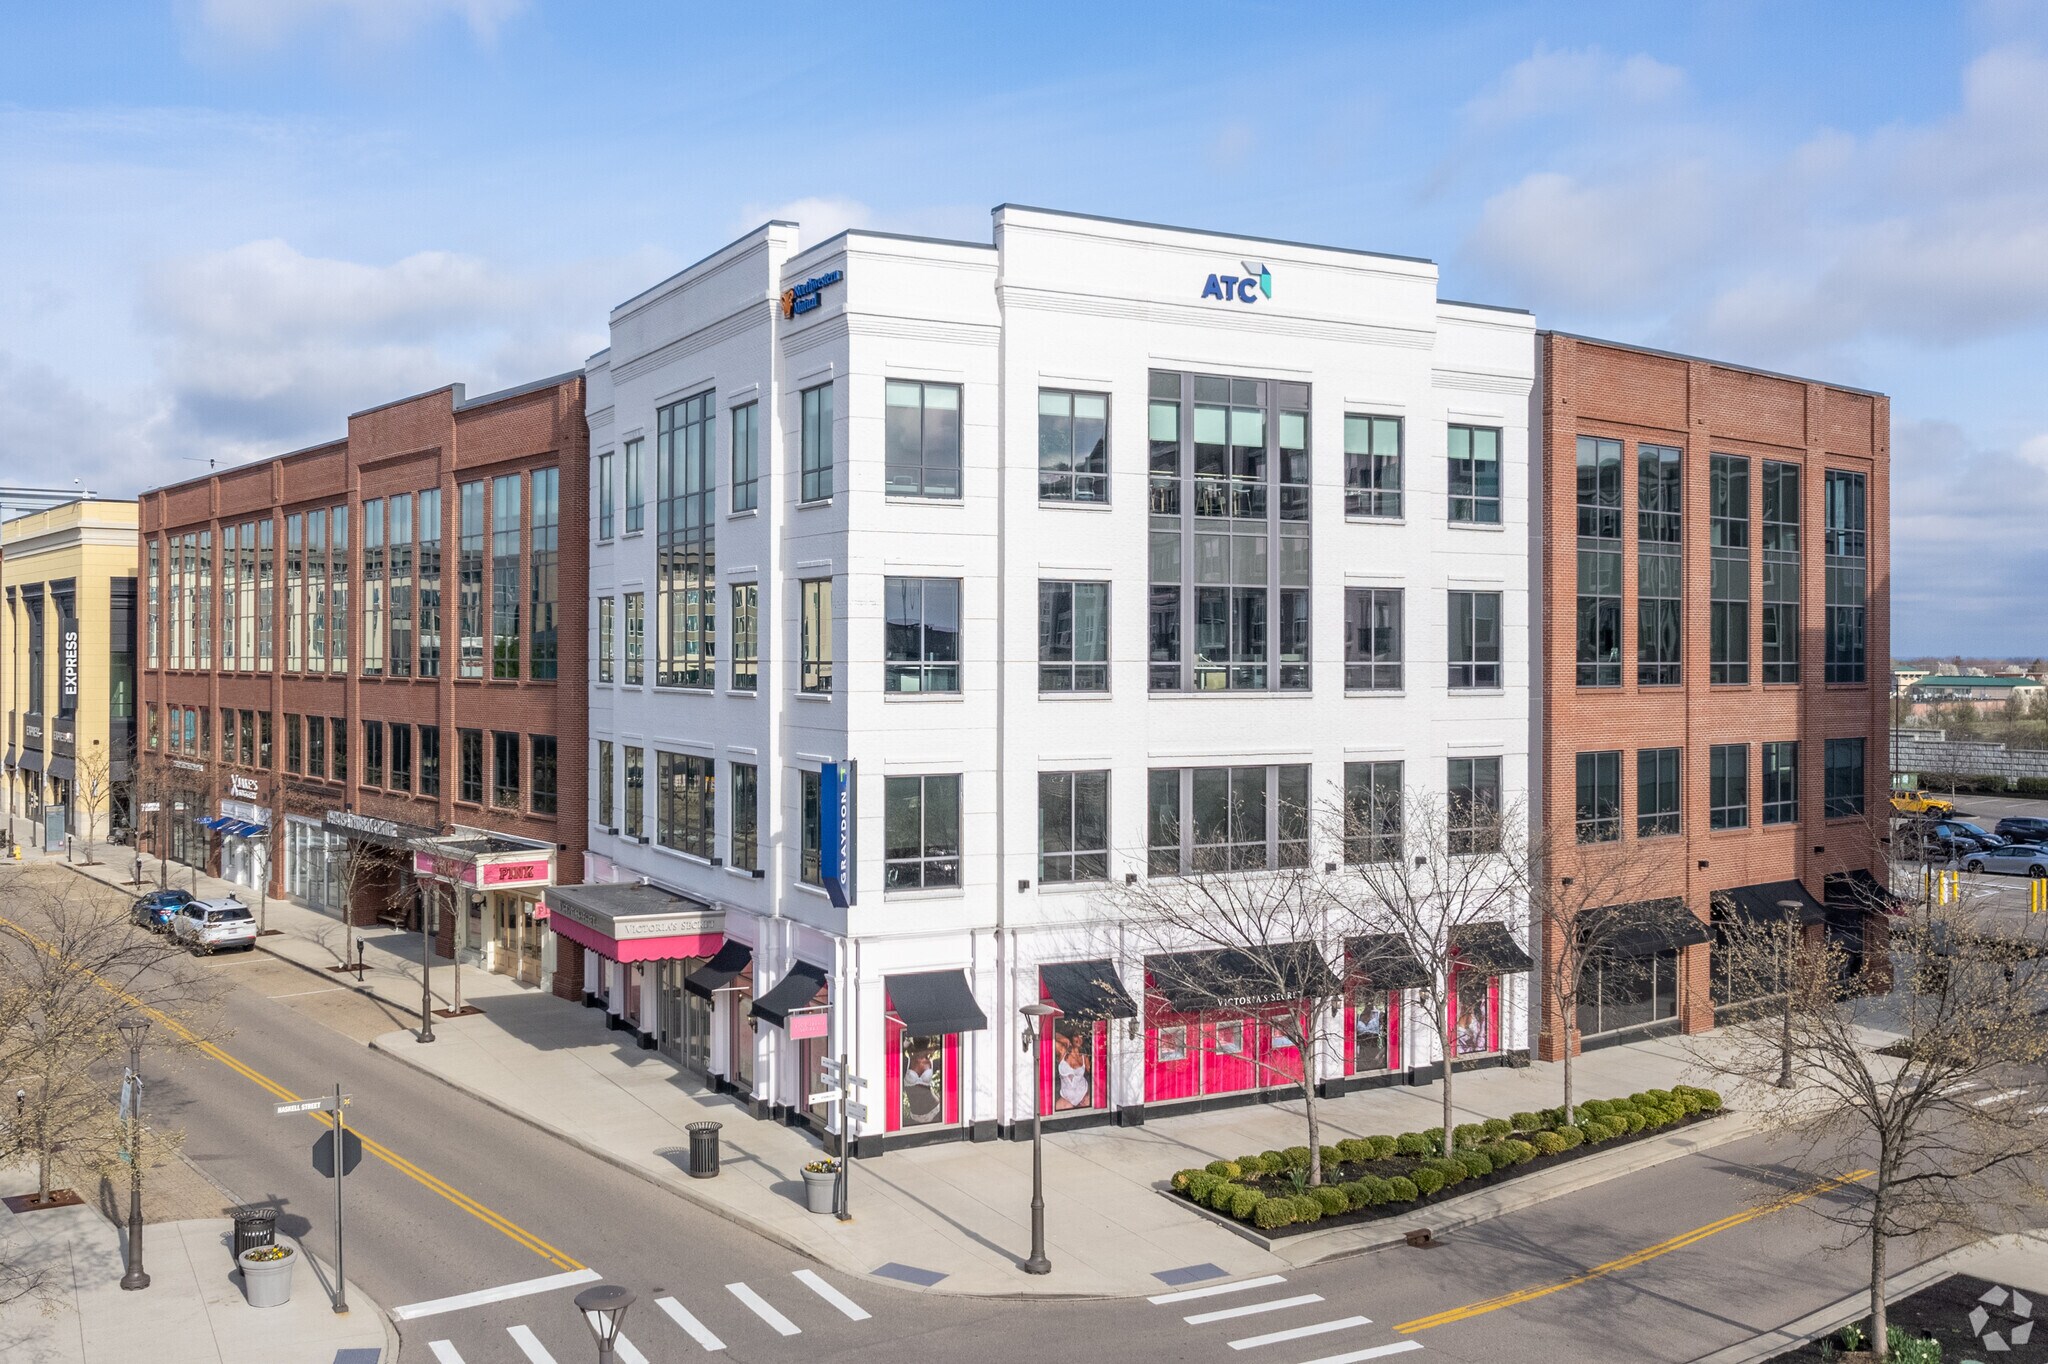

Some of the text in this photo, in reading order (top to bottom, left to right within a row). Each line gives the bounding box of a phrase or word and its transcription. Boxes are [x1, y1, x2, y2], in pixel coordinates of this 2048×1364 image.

[1201, 273, 1258, 303] ATC
[65, 631, 78, 695] EXPRESS
[499, 865, 534, 881] PINK
[624, 920, 715, 934] VICTORIA'S SECRET
[301, 1101, 321, 1111] STREET
